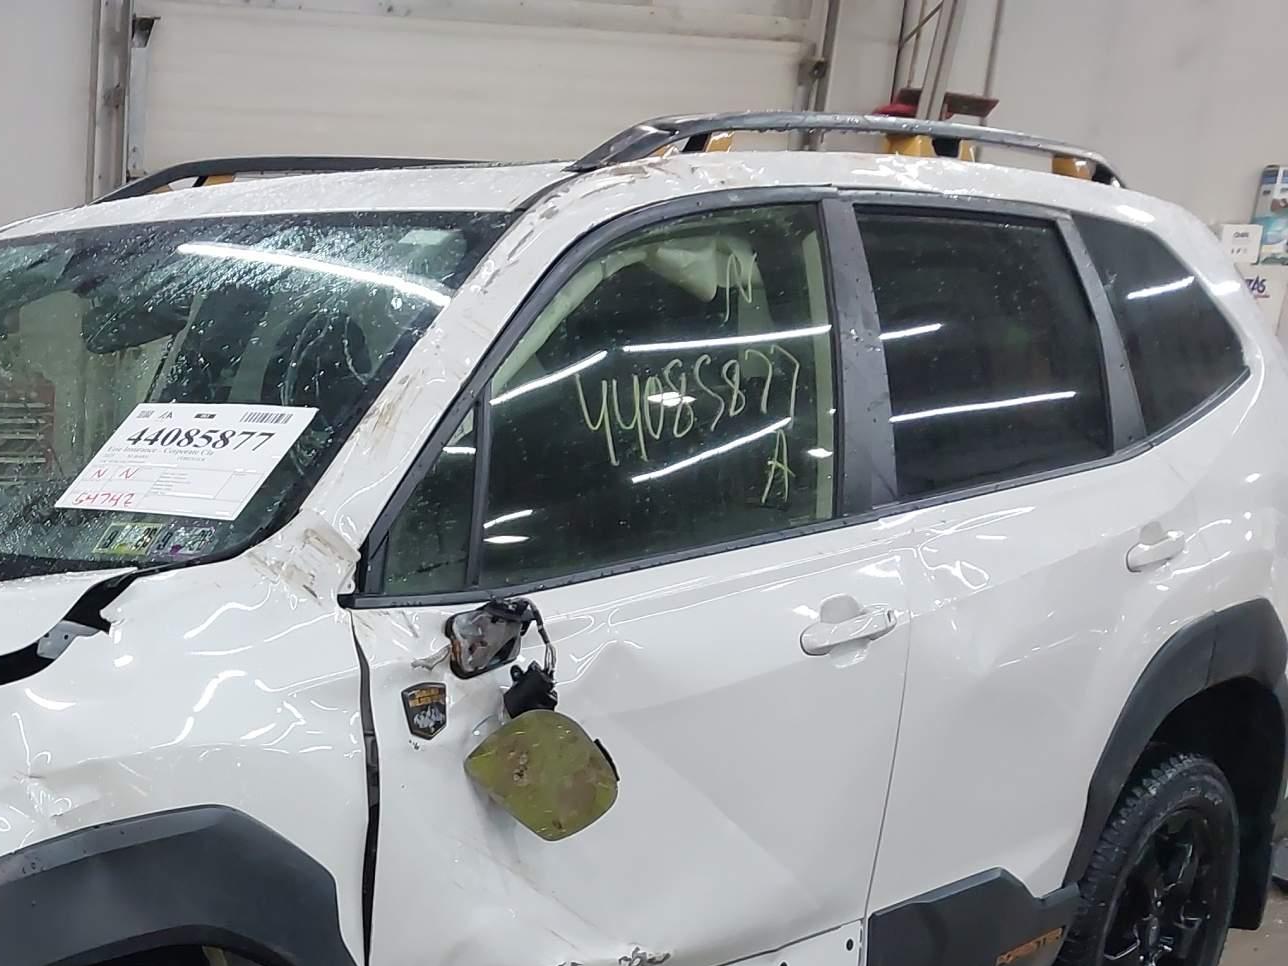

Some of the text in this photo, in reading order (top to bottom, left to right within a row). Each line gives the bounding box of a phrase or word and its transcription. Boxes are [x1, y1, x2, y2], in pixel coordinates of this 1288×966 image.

[126, 426, 276, 452] 44085877
[575, 344, 800, 467] 44085877
[761, 429, 796, 505] A
